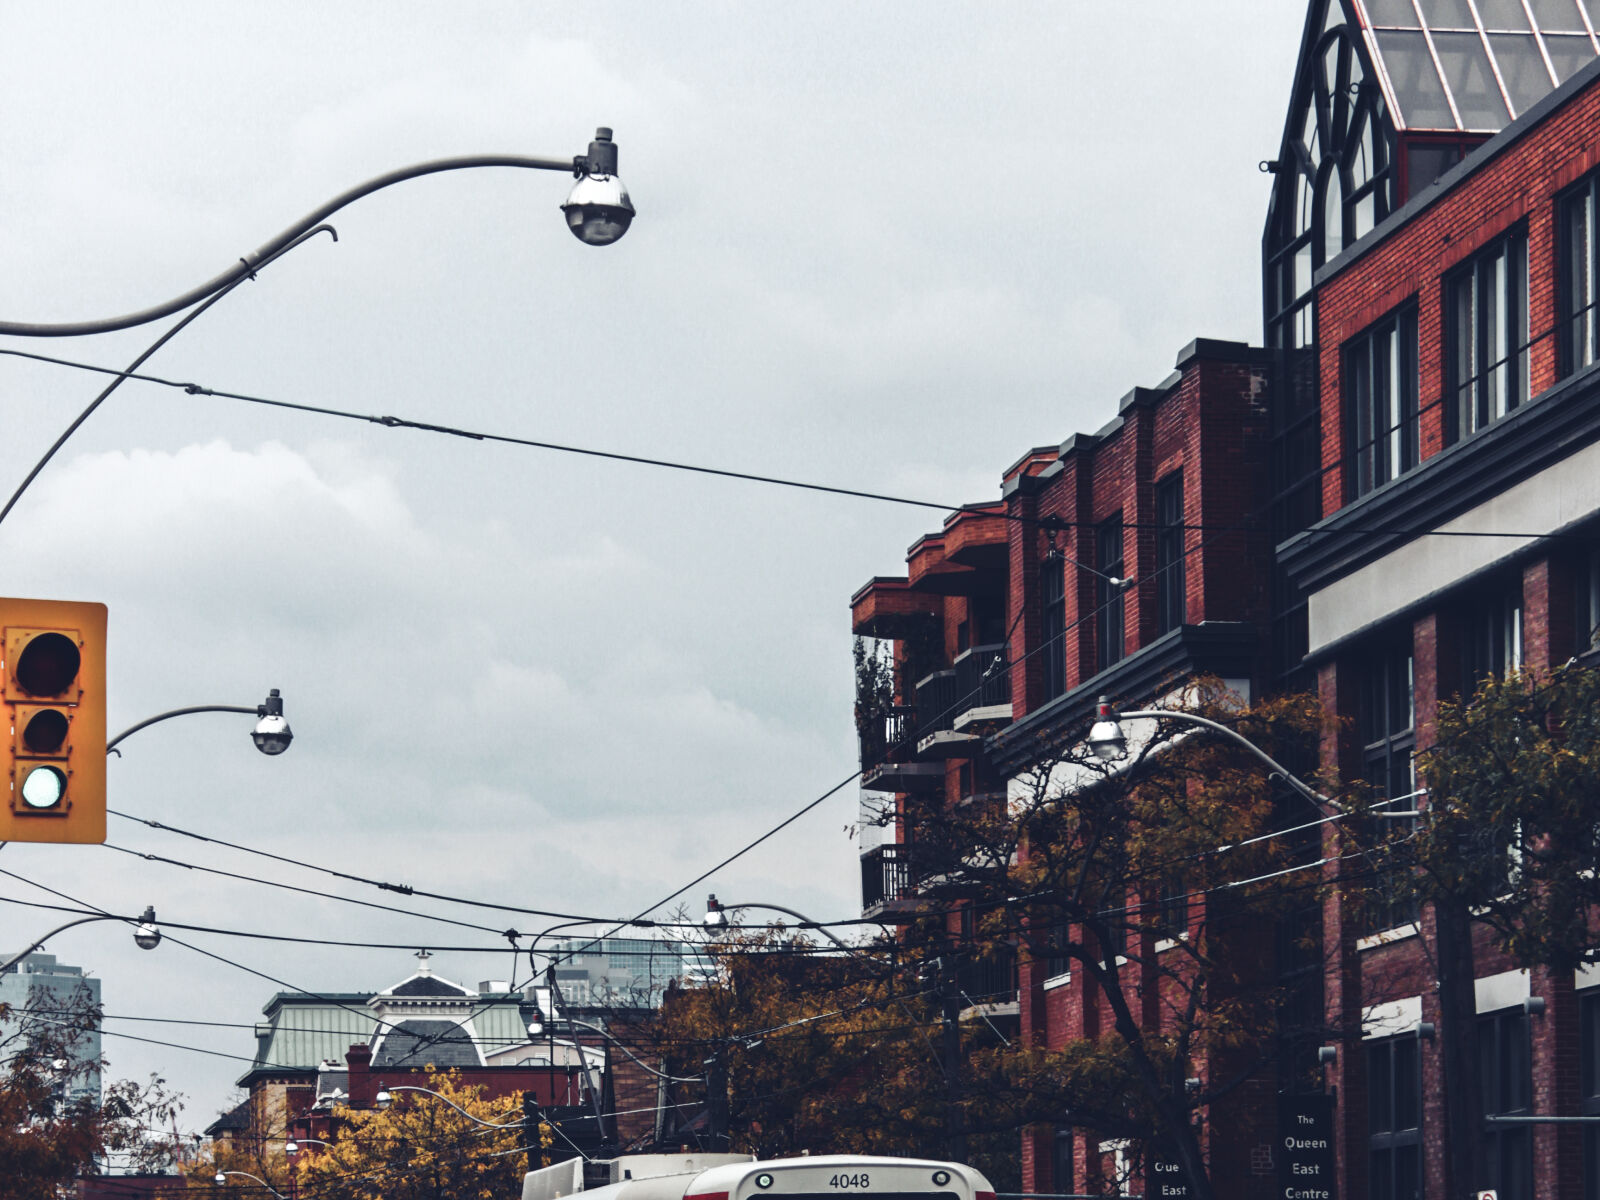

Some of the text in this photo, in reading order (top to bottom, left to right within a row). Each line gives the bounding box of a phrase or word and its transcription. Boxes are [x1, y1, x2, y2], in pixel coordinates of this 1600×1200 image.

[1297, 1115, 1315, 1125] The
[1285, 1136, 1327, 1151] Queen
[1154, 1161, 1180, 1173] Que
[1292, 1162, 1320, 1175] East
[829, 1173, 870, 1189] 4048
[1161, 1184, 1187, 1196] East
[1284, 1187, 1329, 1199] Centre
